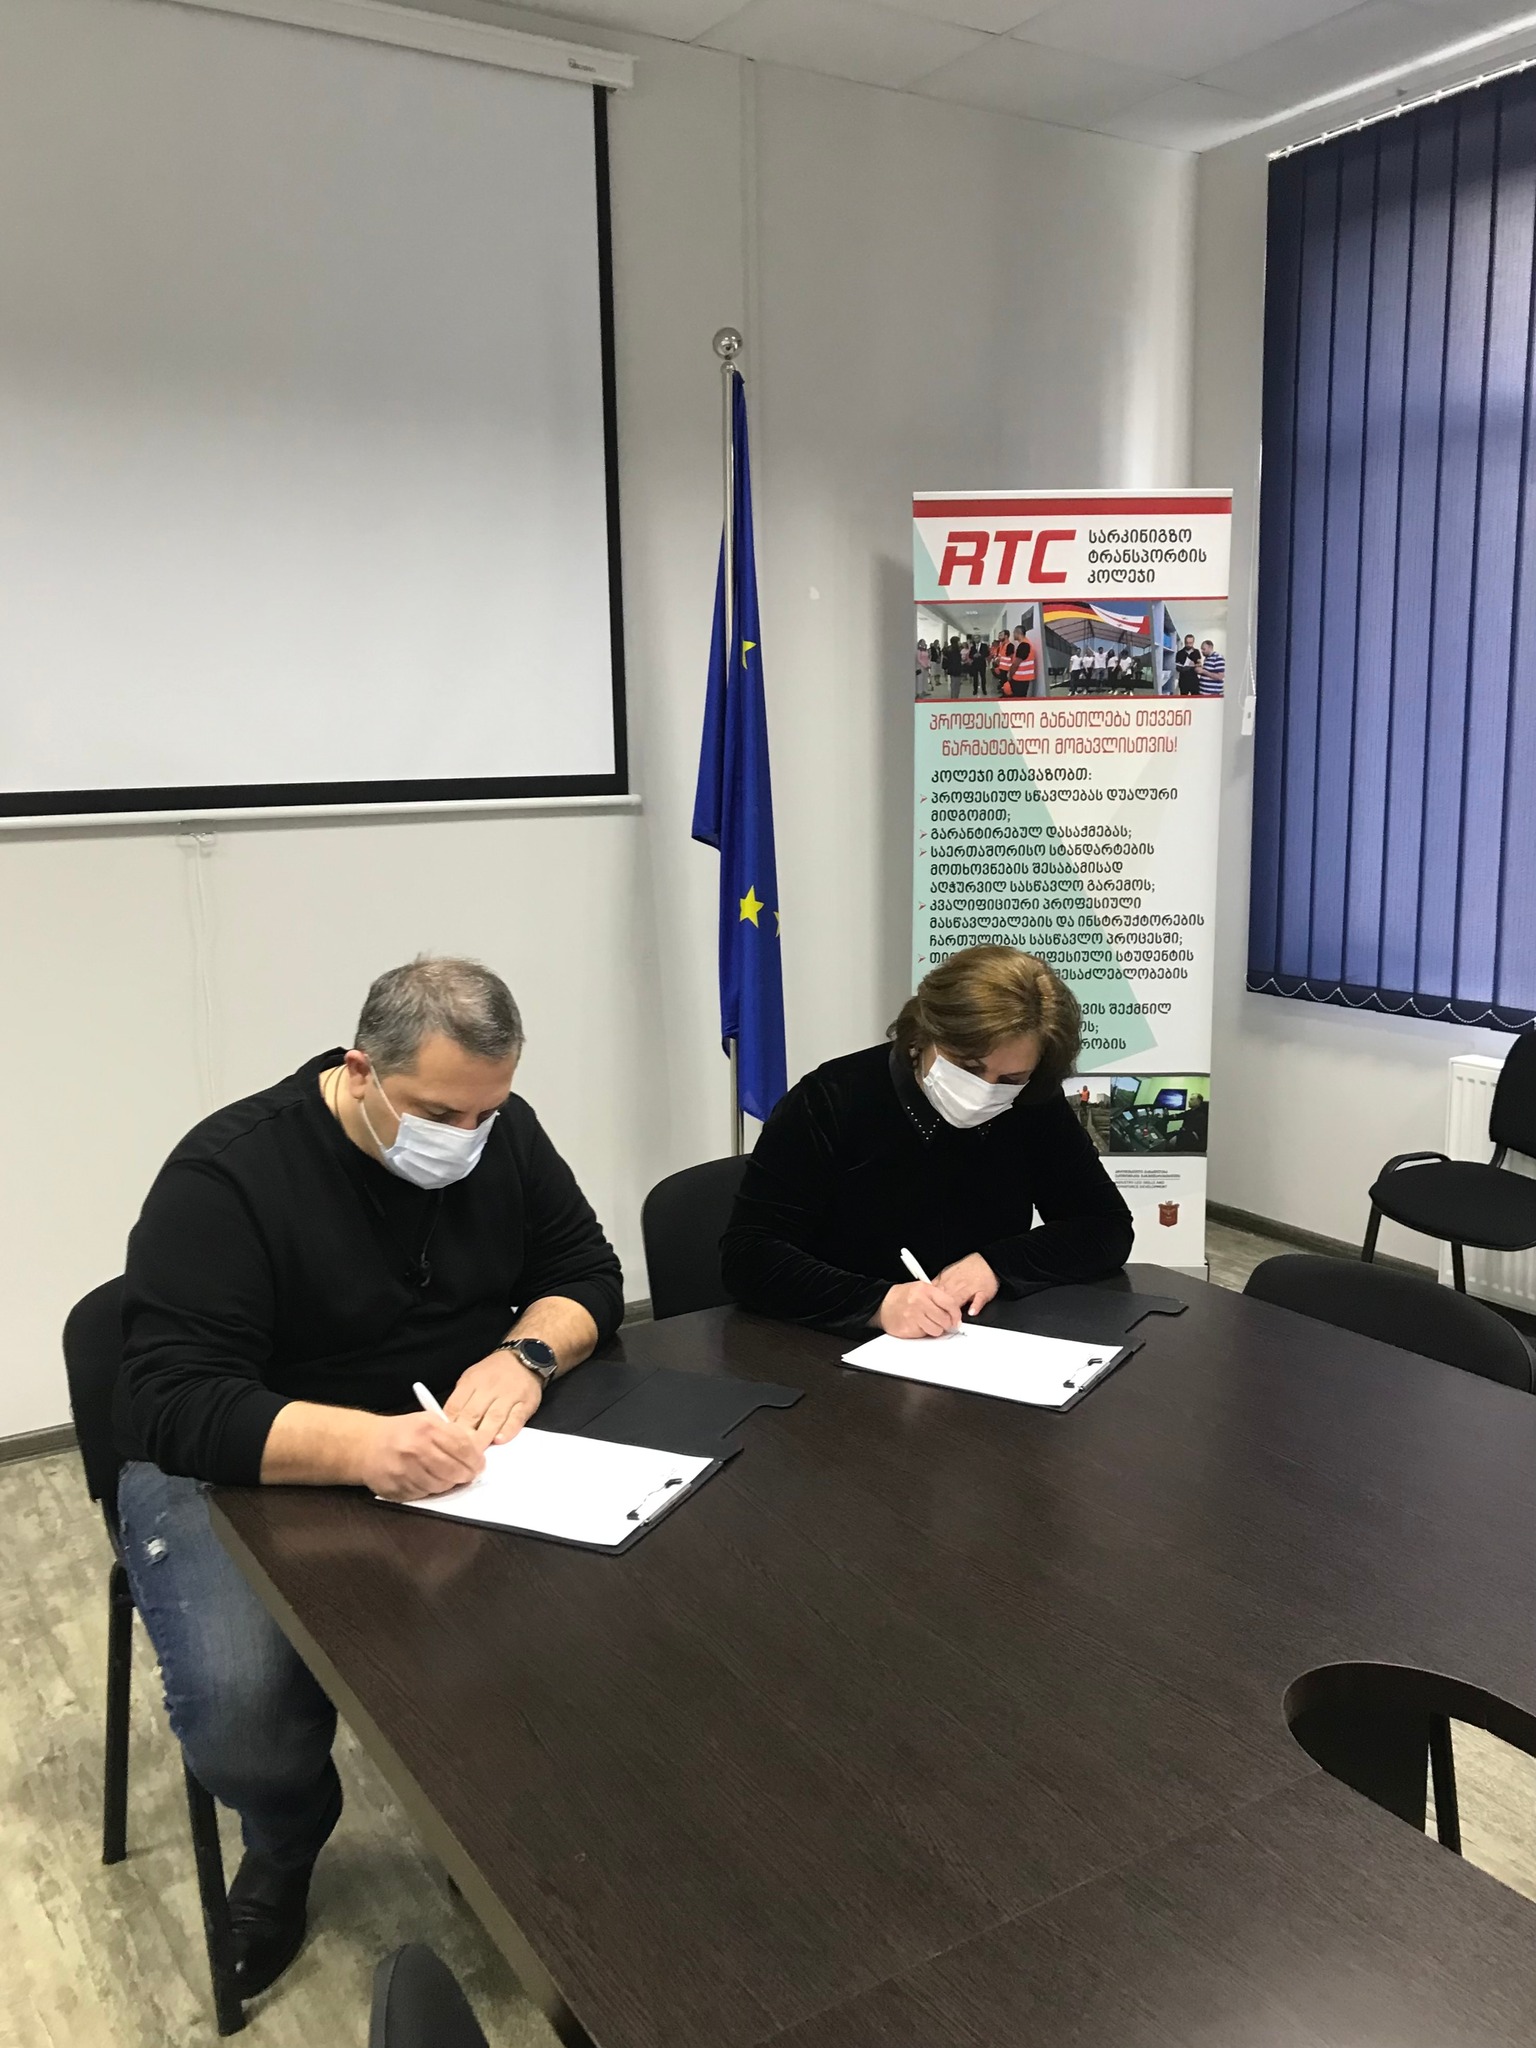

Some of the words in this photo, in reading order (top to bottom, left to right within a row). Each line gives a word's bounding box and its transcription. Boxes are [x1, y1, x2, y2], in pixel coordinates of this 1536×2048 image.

[1089, 529, 1192, 544] სარკინიგზო
[938, 530, 1076, 586] RTC
[1088, 548, 1207, 563] ტრანსპორტის
[1087, 569, 1155, 583] კოლეჯი
[930, 712, 1034, 730] პროფესიული
[1040, 711, 1130, 728] განათლება
[1136, 710, 1191, 726] თქვენი
[942, 738, 1049, 756] წარმატებული
[931, 769, 993, 783] კოლეჯი
[997, 768, 1091, 782] გთავაზობთ:
[931, 790, 1022, 803] პროფესიულ
[1025, 789, 1103, 802] სწავლებას
[1107, 788, 1177, 801] დუალური
[931, 826, 1043, 840] გარანტირებულ
[931, 844, 1046, 858] საერთაშორისო
[1049, 843, 1154, 856] სტანდარტების
[930, 862, 1029, 875] მოთხოვნების
[1032, 861, 1123, 874] შესაბამისად
[1010, 880, 1084, 892] სასწავლო
[1043, 897, 1141, 910] პროფესიული
[930, 916, 1053, 929] მასწავლებლების
[1056, 916, 1074, 927] და
[1078, 914, 1204, 927] ინსტრუქტორების
[1030, 933, 1103, 945] სასწავლო
[1027, 950, 1113, 964] ოფესიული
[1116, 950, 1194, 962] სტუდენტის
[1109, 1003, 1171, 1015] შექმნილ
